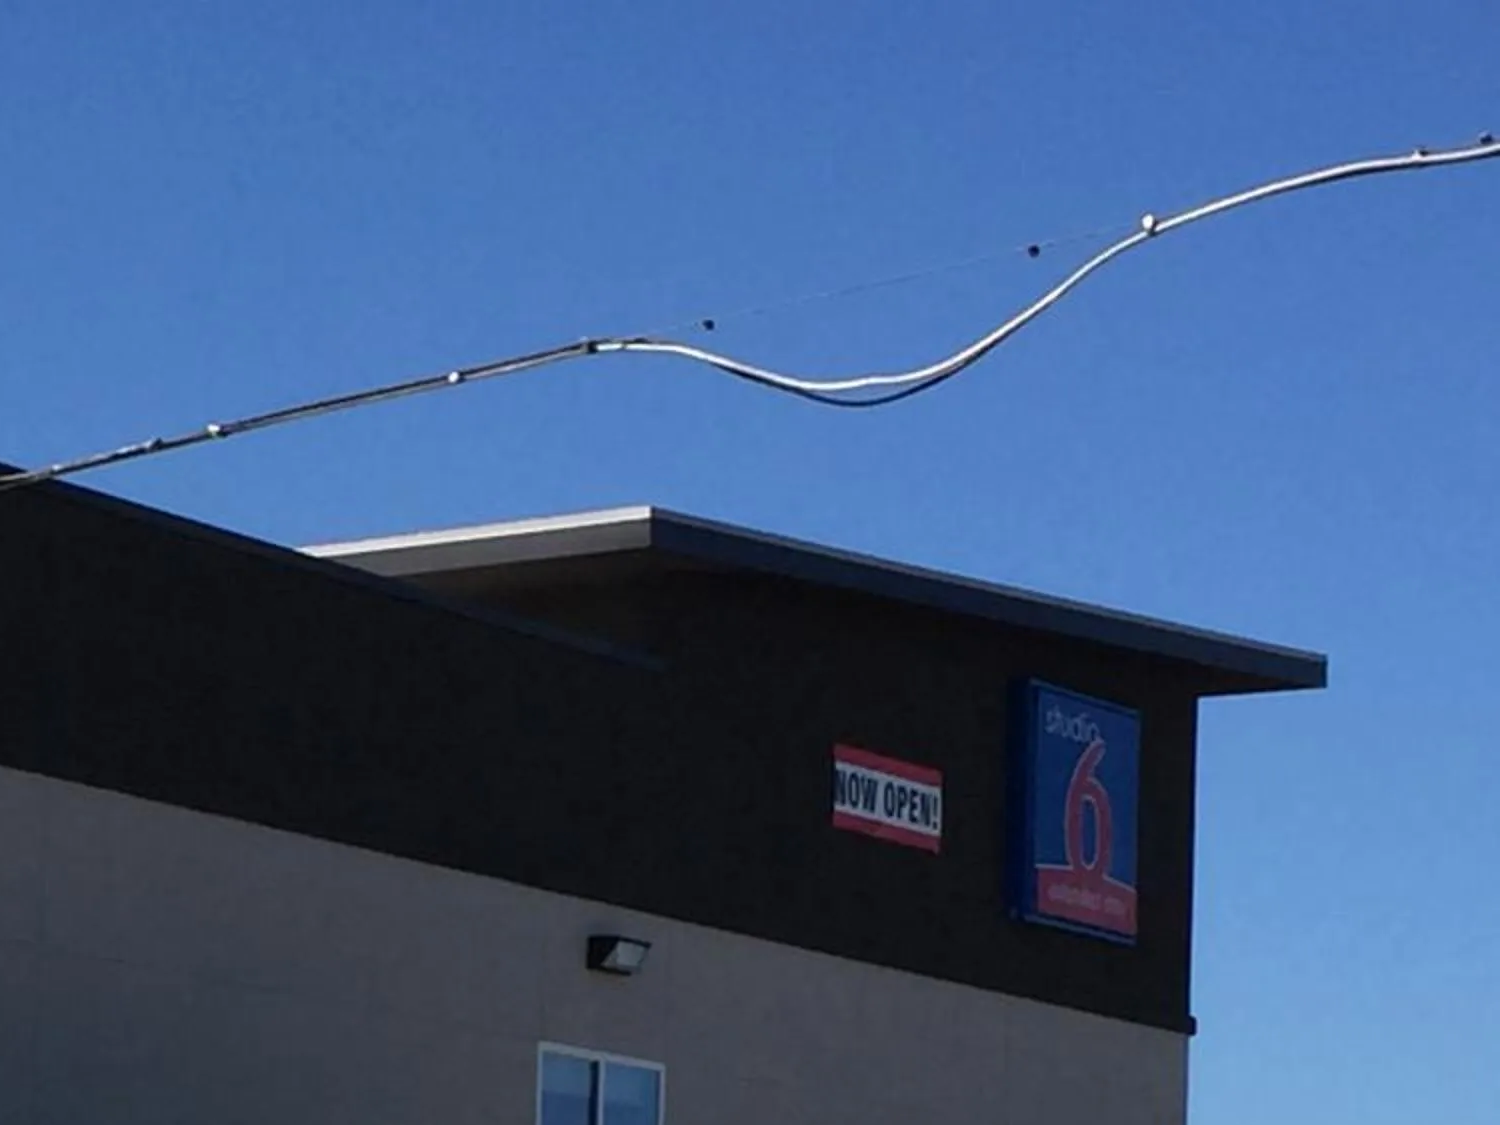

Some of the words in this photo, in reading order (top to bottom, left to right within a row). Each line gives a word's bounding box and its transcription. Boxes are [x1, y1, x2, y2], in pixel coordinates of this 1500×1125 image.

[1044, 704, 1100, 744] studio
[835, 767, 877, 813] NOW
[883, 779, 939, 830] OPEN!
[1064, 737, 1112, 871] 6
